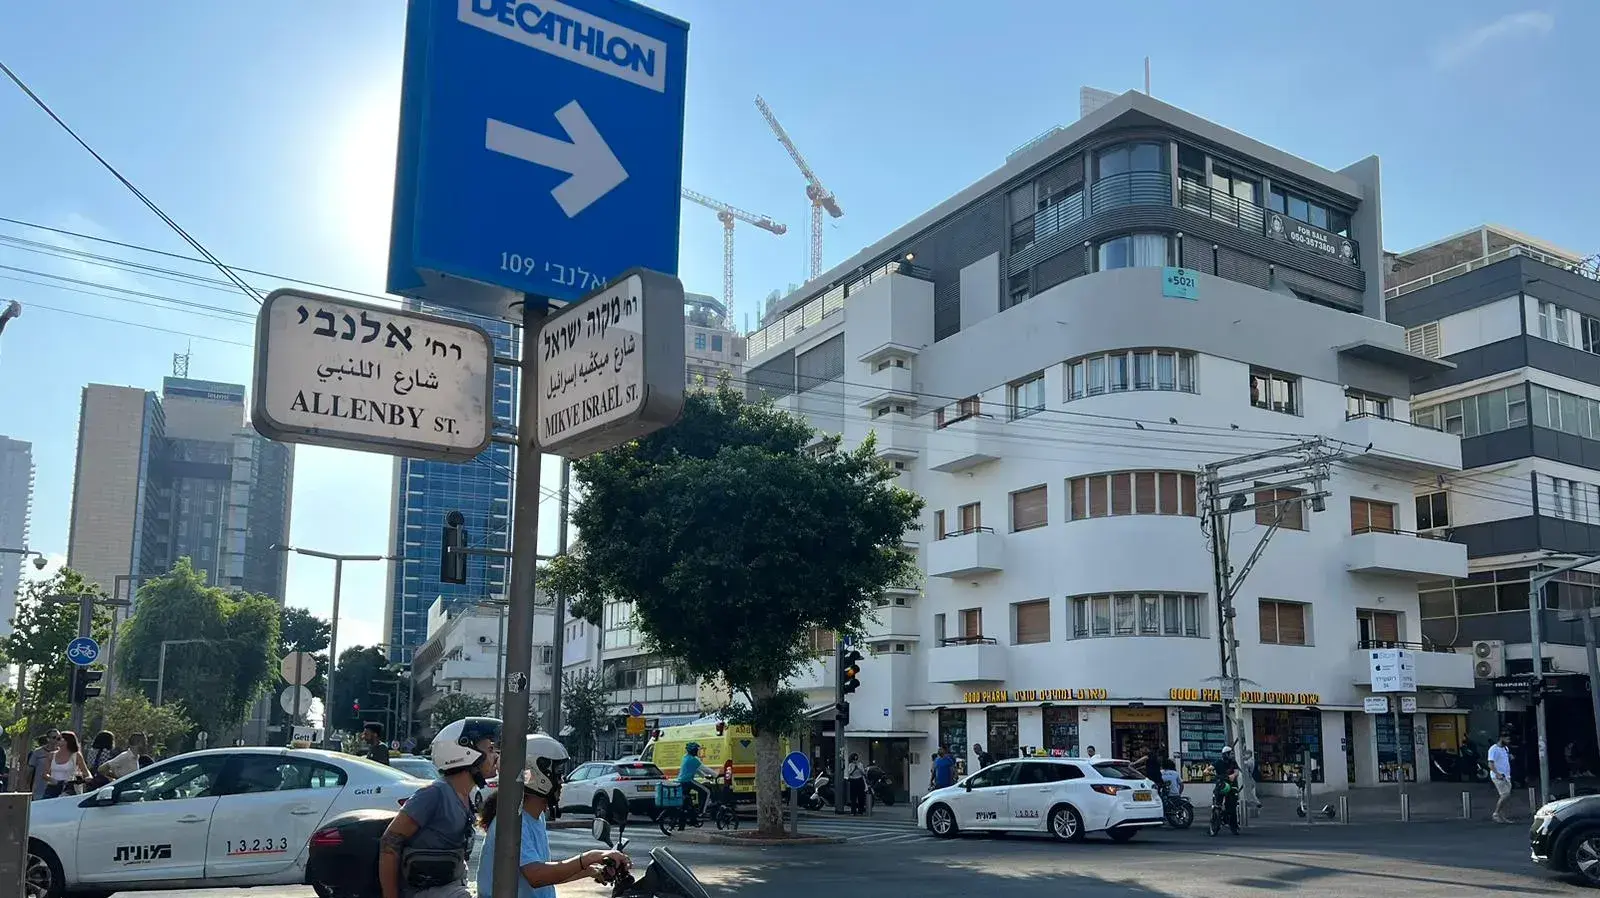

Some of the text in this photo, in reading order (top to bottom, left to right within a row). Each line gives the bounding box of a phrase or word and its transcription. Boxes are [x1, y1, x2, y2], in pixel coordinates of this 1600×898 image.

[472, 0, 656, 77] DECATHLON
[1297, 226, 1328, 242] FOR SALE
[501, 251, 607, 289] אלנבי 109
[297, 305, 413, 351] אלנבי
[587, 296, 620, 340] מקוה
[544, 318, 582, 362] ישראל
[614, 334, 636, 373] شارع
[317, 358, 439, 395] شارع اللنبي
[290, 390, 460, 435] ALLENBY ST.
[545, 384, 639, 439] MIKVE ISRAEL ST.
[964, 690, 1008, 703] GOOD PHARM
[1169, 687, 1198, 700] GOOD
[1201, 688, 1221, 701] PHA
[293, 733, 310, 741] Gett
[113, 844, 171, 861] מונית
